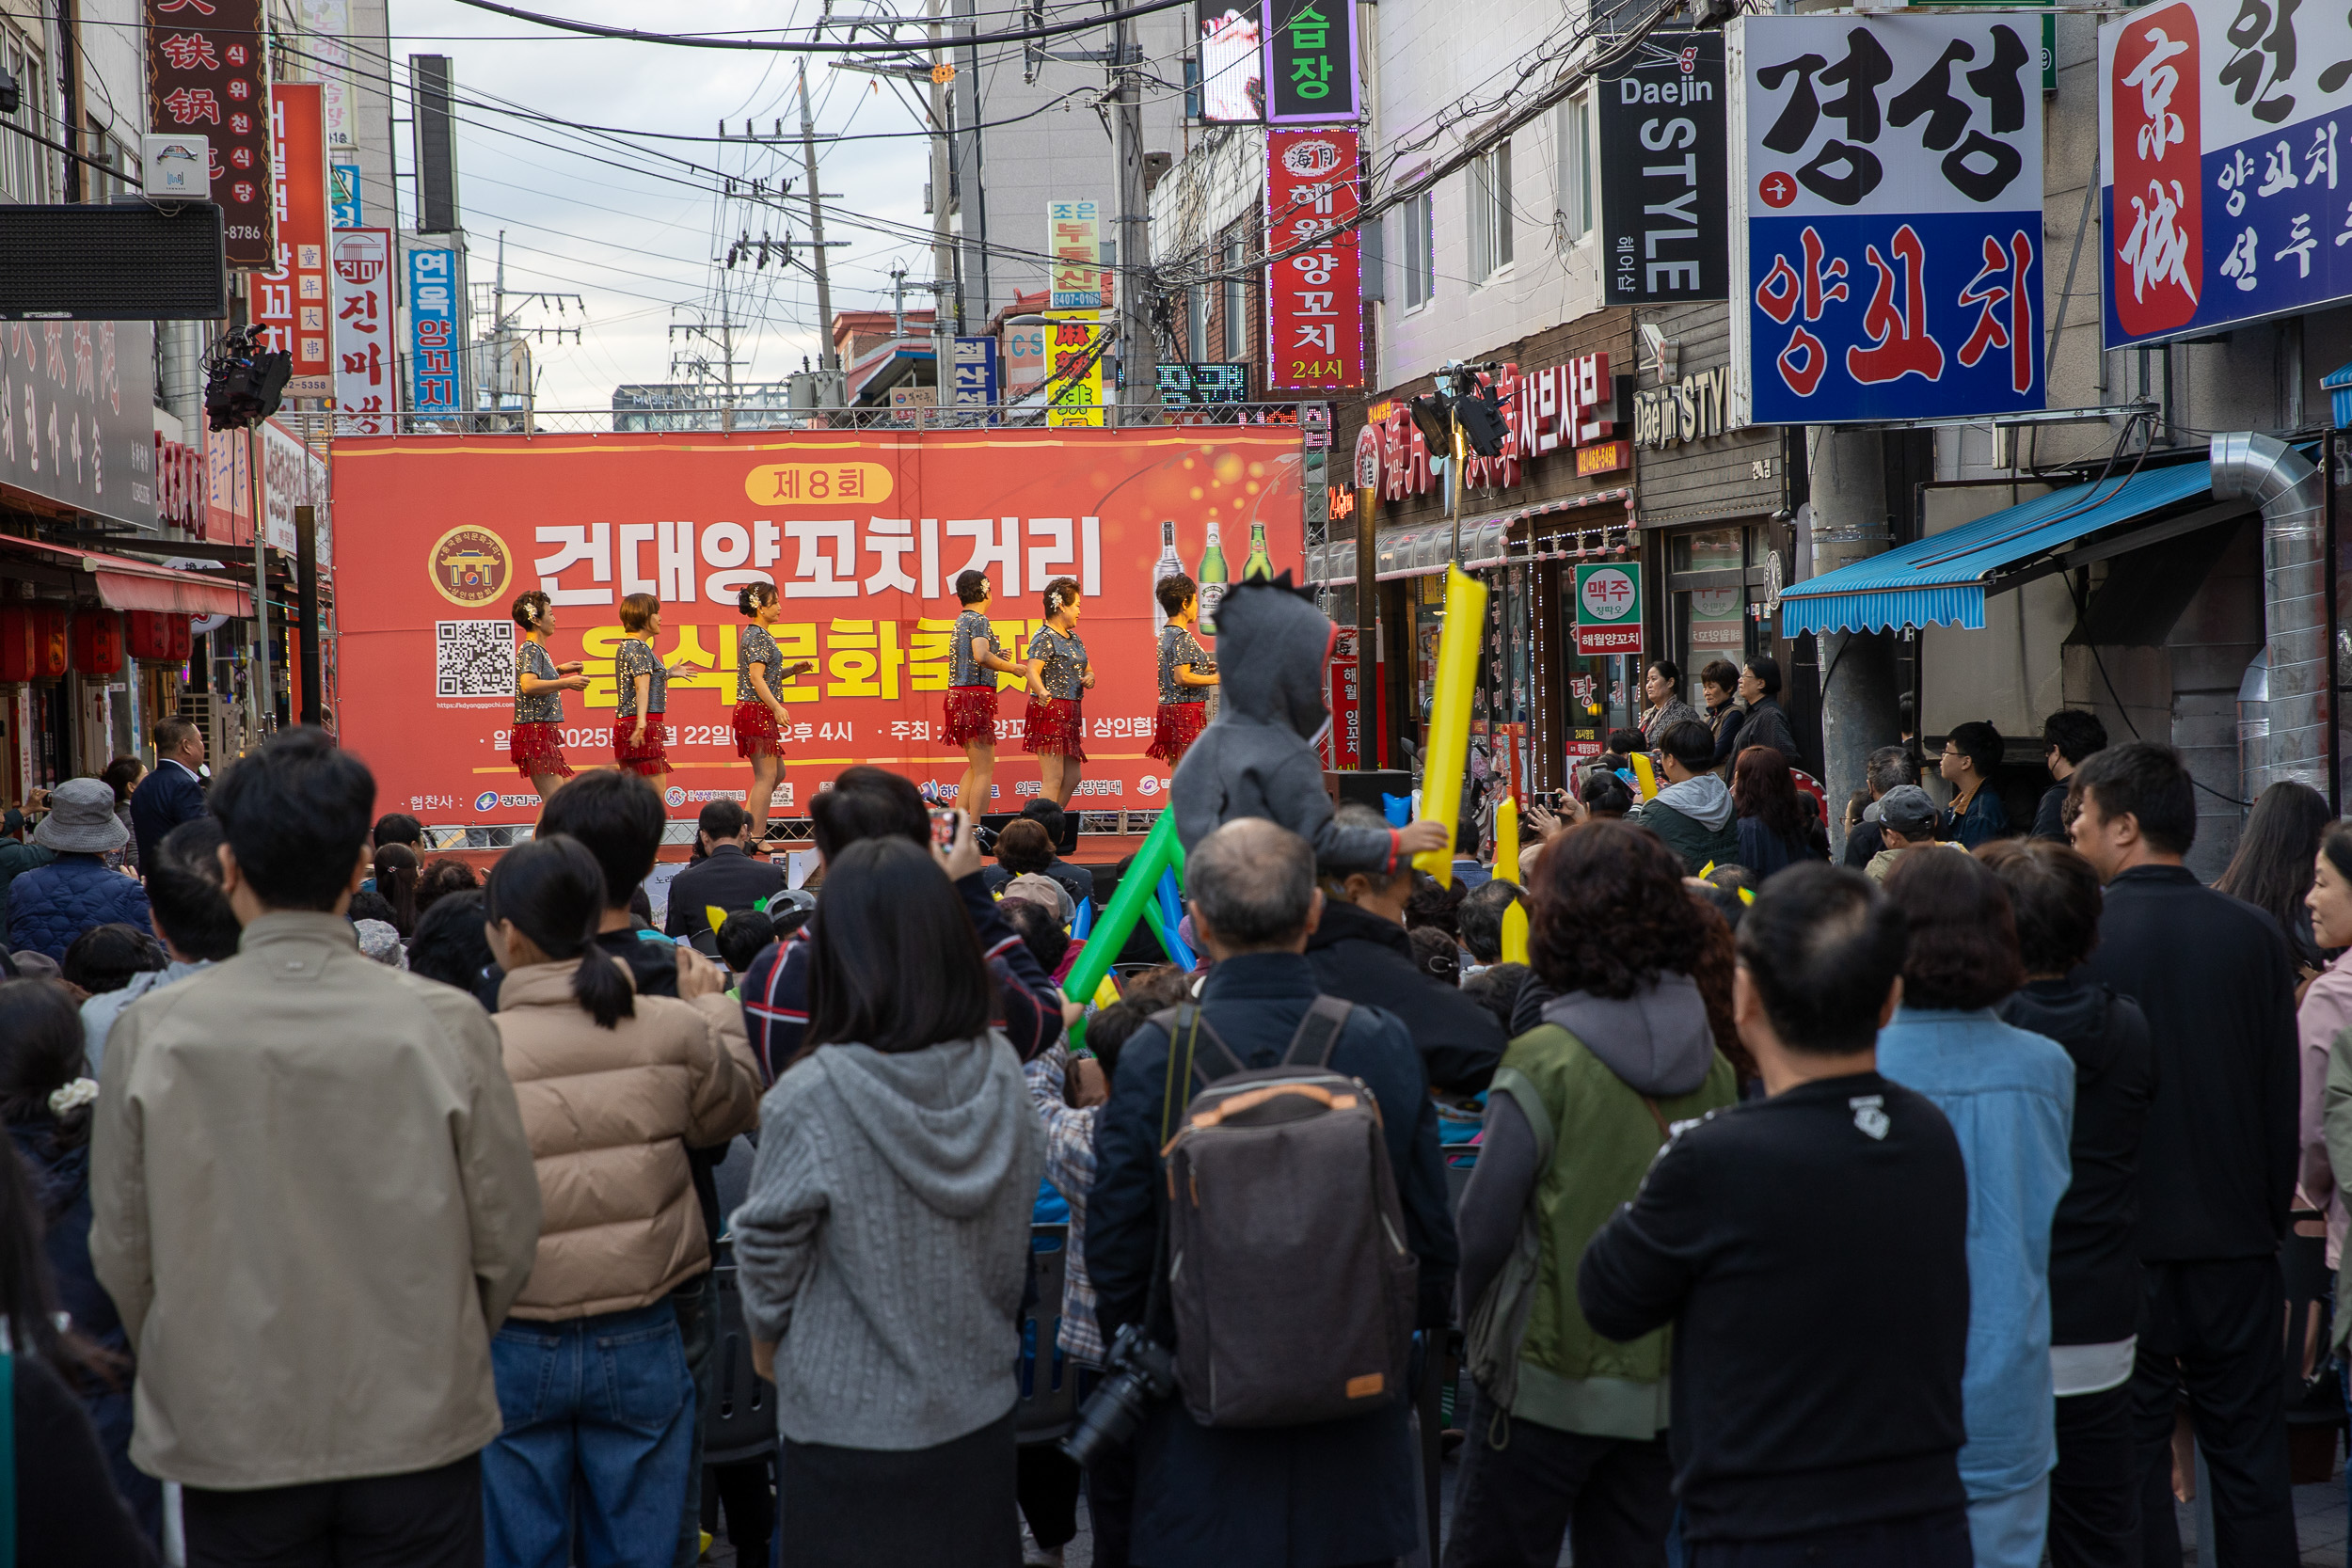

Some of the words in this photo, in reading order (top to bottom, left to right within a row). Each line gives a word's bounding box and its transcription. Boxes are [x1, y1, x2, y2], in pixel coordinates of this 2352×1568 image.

[2219, 0, 2352, 123] 원
[1621, 77, 1712, 106] Daejin
[228, 46, 253, 202] 식위천식당
[1756, 24, 2029, 206] 경성
[1053, 202, 1096, 219] 조은
[1640, 118, 1700, 293] STYLE
[1056, 222, 1097, 290] 부동산
[1288, 182, 1340, 355] 해월양꼬치
[1616, 236, 1635, 293] 헤어샵
[340, 261, 379, 279] 진미
[301, 247, 320, 359] 童年大串
[1054, 293, 1100, 306] 6407-0100
[1055, 316, 1093, 426] 麻辣排
[1292, 359, 1342, 380] 24시
[1520, 353, 1600, 457] 샤브샤브
[1634, 387, 1677, 450] Daejin
[1681, 366, 1732, 442] STY
[441, 532, 501, 554] 중국음식문화거리
[534, 515, 1101, 606] 건대양꼬치거리
[452, 588, 492, 600] 상인연합회
[1588, 580, 1630, 602] 맥주
[1596, 605, 1623, 615] 칭따오
[1581, 632, 1639, 647] 해월양꼬치
[819, 721, 853, 742] 4시
[890, 721, 930, 741] 주최
[1093, 717, 1157, 738] 상인협
[409, 794, 453, 811] 협찬사
[501, 794, 542, 807] 광진구
